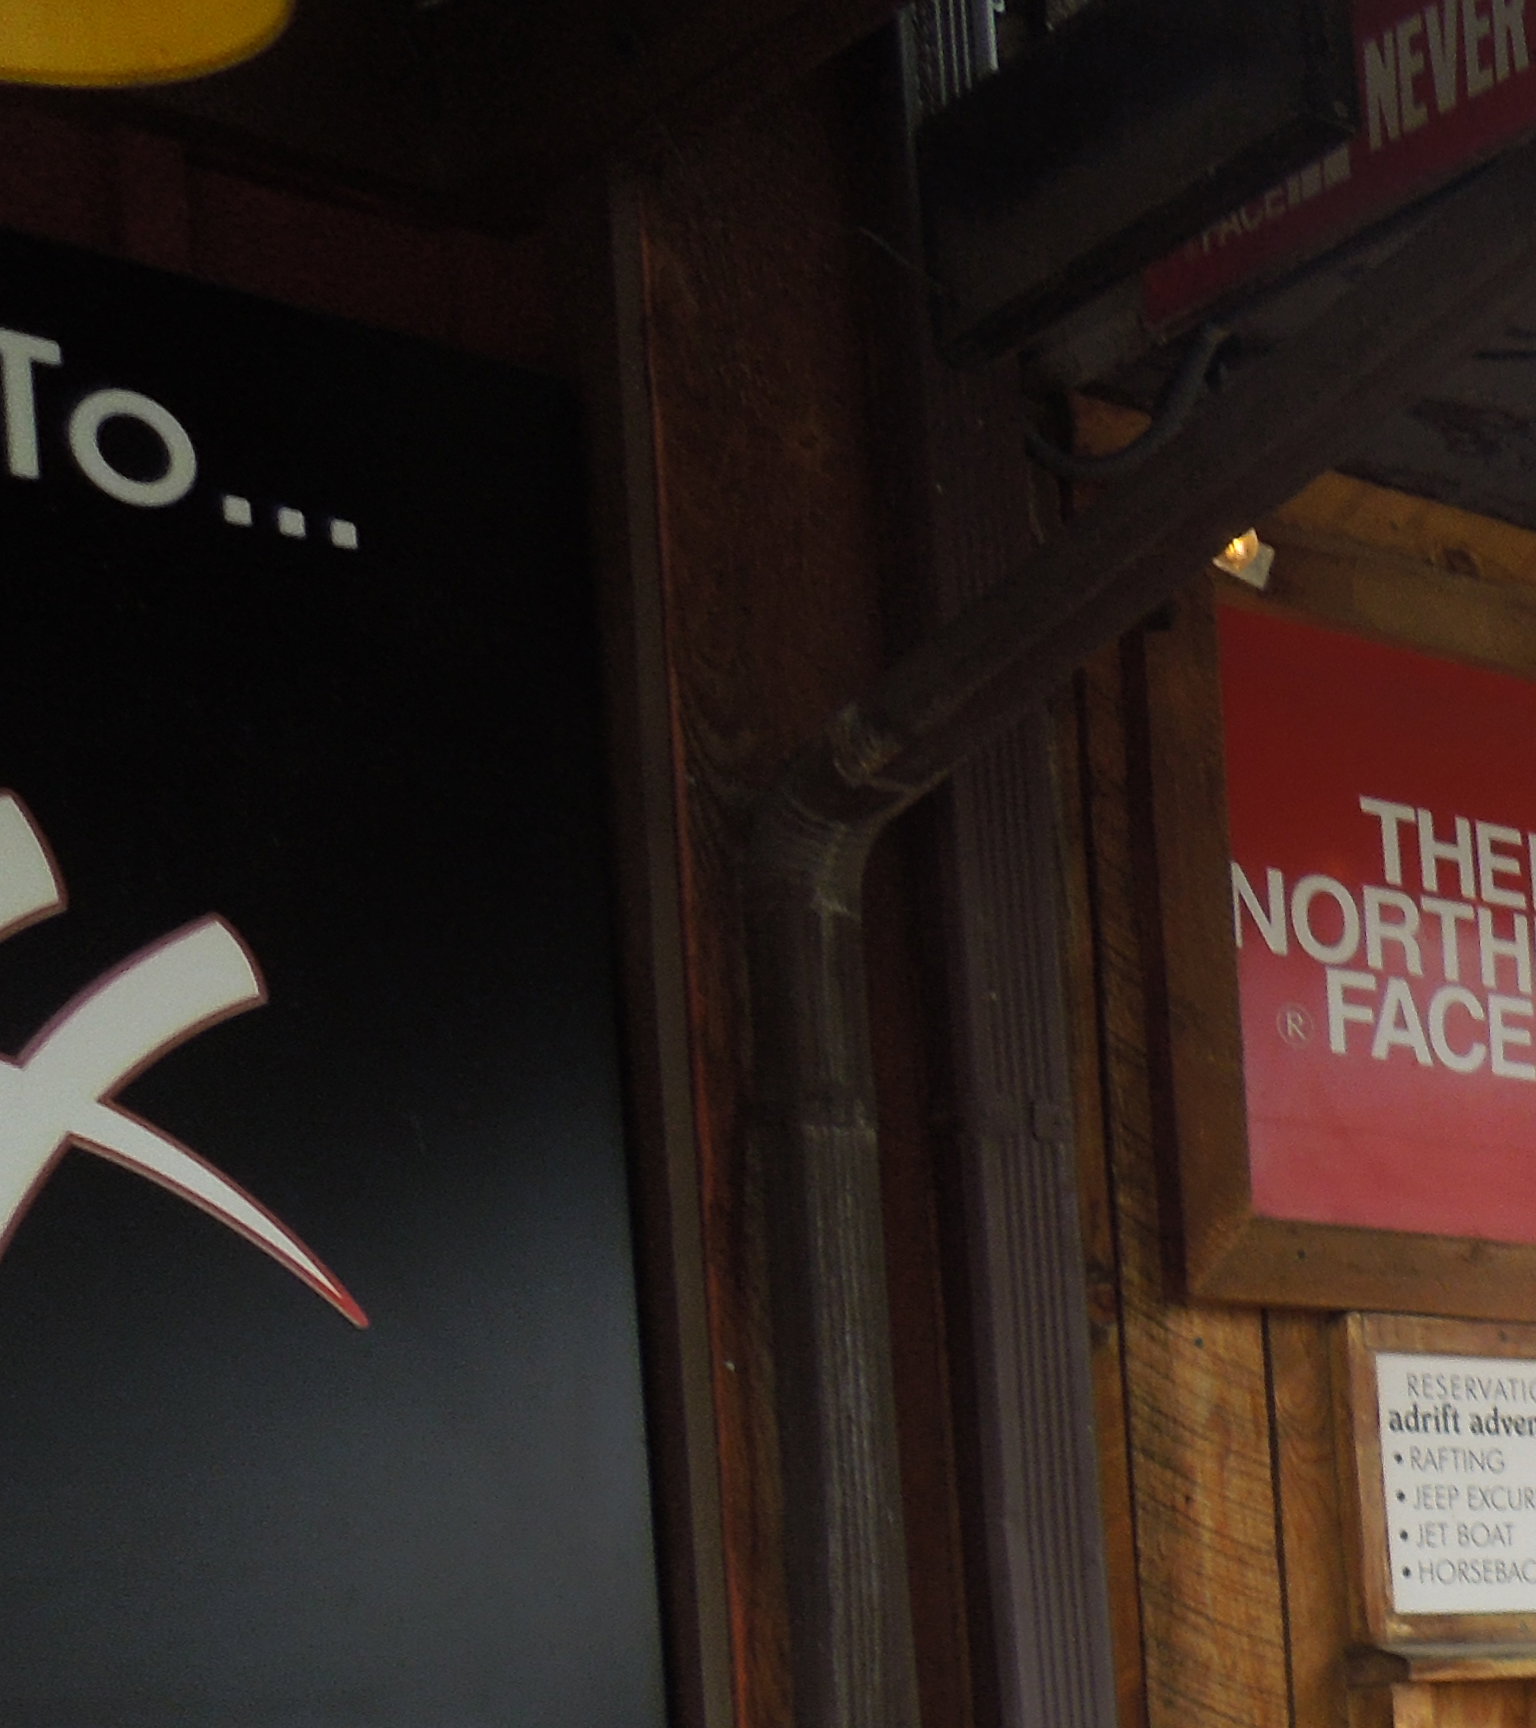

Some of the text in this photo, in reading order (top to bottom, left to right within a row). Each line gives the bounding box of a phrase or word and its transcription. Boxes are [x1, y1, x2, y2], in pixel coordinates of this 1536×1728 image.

[1359, 795, 1527, 907] THE
[1229, 859, 1533, 995] NORTH
[1388, 1402, 1461, 1435] adrift
[1410, 1446, 1505, 1474] RAFTING
[1413, 1484, 1459, 1511] JEEP
[1415, 1521, 1515, 1548] JET BOAT
